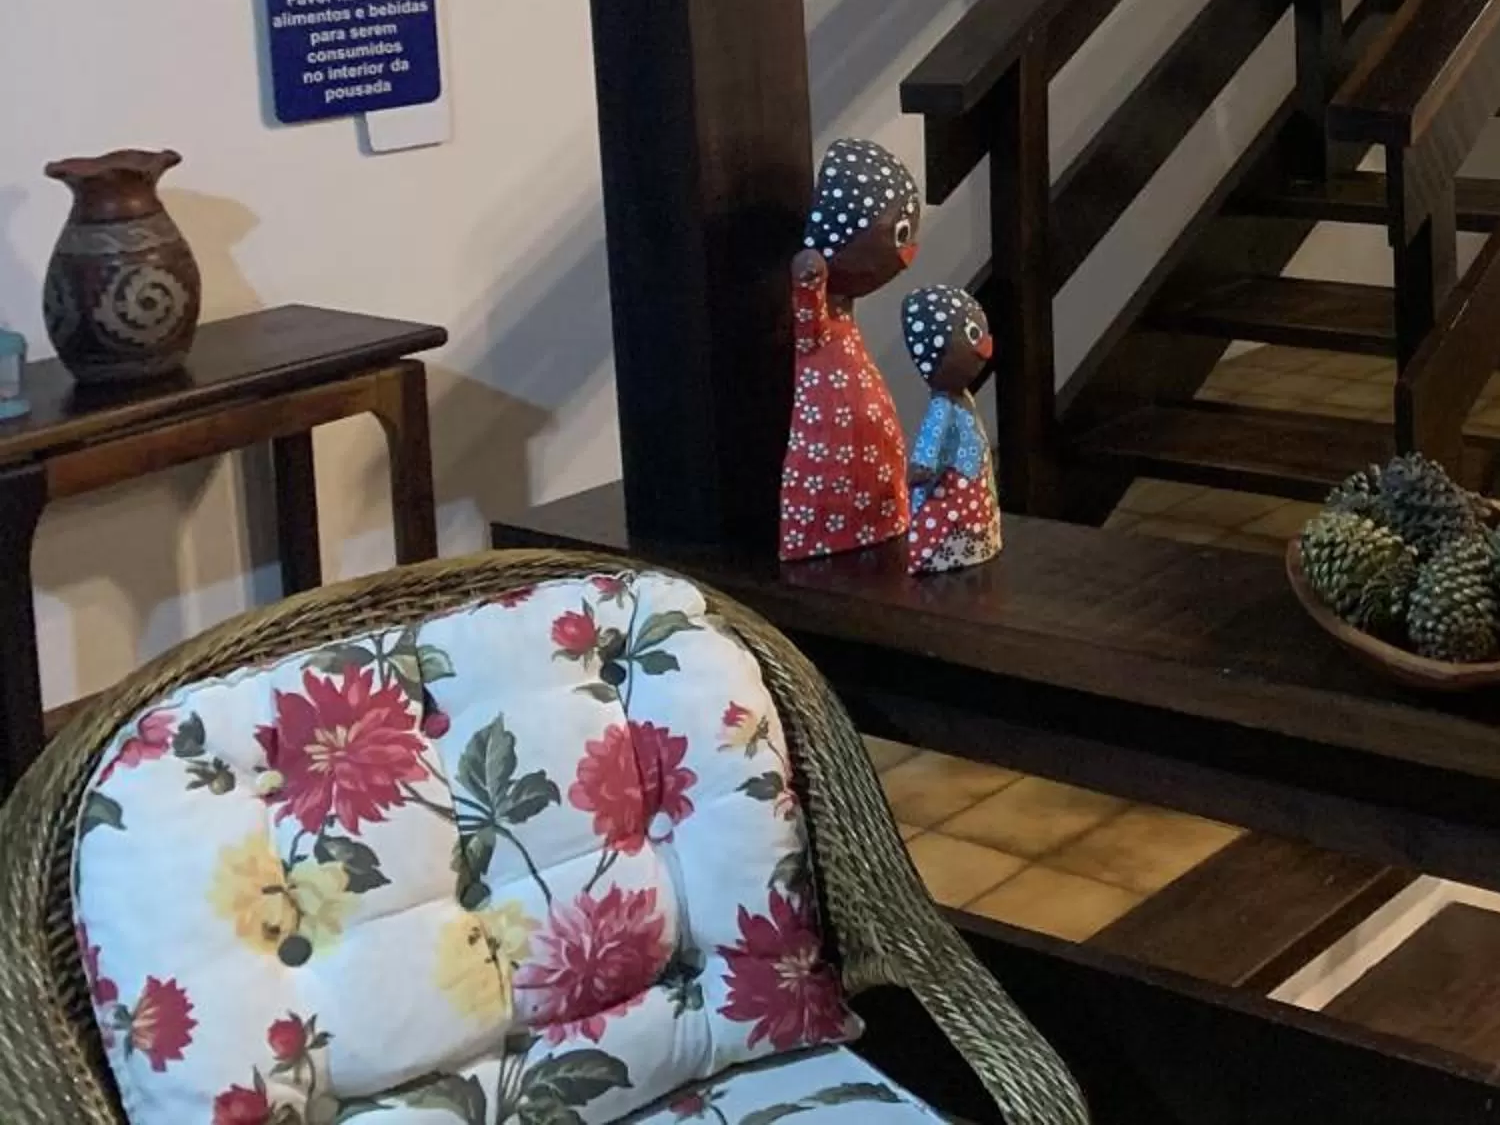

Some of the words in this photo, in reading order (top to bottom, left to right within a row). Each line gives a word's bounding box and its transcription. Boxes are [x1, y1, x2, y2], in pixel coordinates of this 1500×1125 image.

[272, 8, 350, 28] alimentos
[355, 8, 365, 19] e
[368, 0, 429, 17] bebidas
[309, 28, 345, 47] para
[350, 24, 397, 40] serem
[306, 41, 403, 64] consumidos
[303, 71, 323, 84] no
[327, 62, 385, 80] interior
[389, 58, 410, 72] da
[324, 79, 392, 103] pousada
